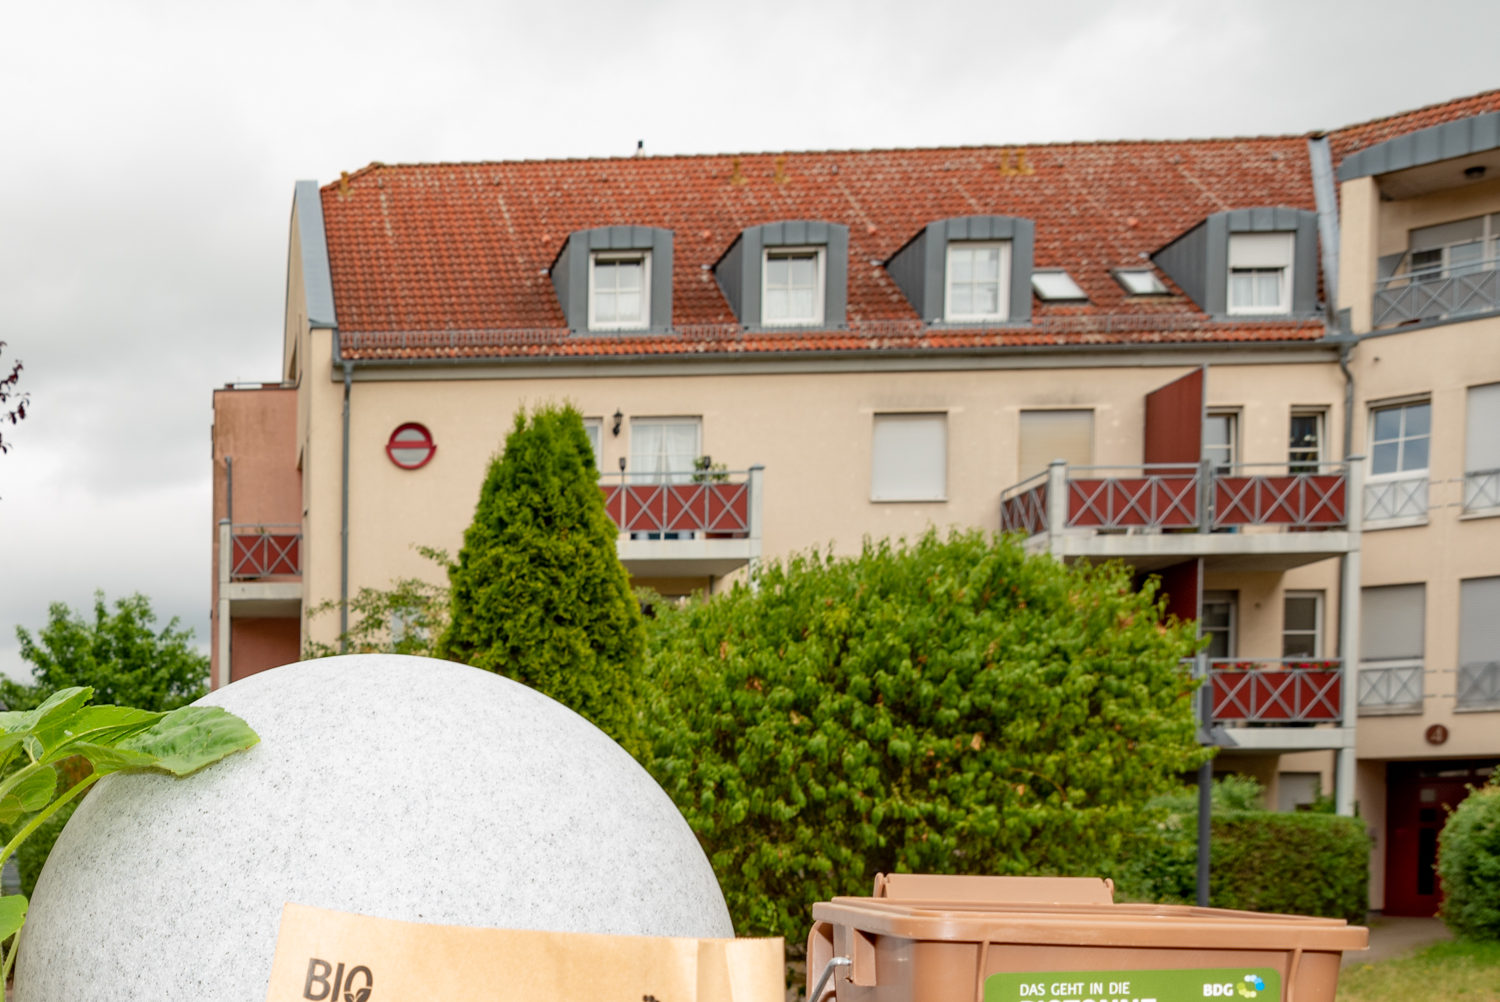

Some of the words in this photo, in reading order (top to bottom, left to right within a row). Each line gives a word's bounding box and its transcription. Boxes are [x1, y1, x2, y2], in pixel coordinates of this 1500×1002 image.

[1430, 726, 1444, 743] 4
[1020, 983, 1046, 997] DAS
[1051, 983, 1085, 996] GEHT
[1090, 983, 1103, 995] IN
[1109, 982, 1130, 995] DIE
[1203, 983, 1234, 997] BDG
